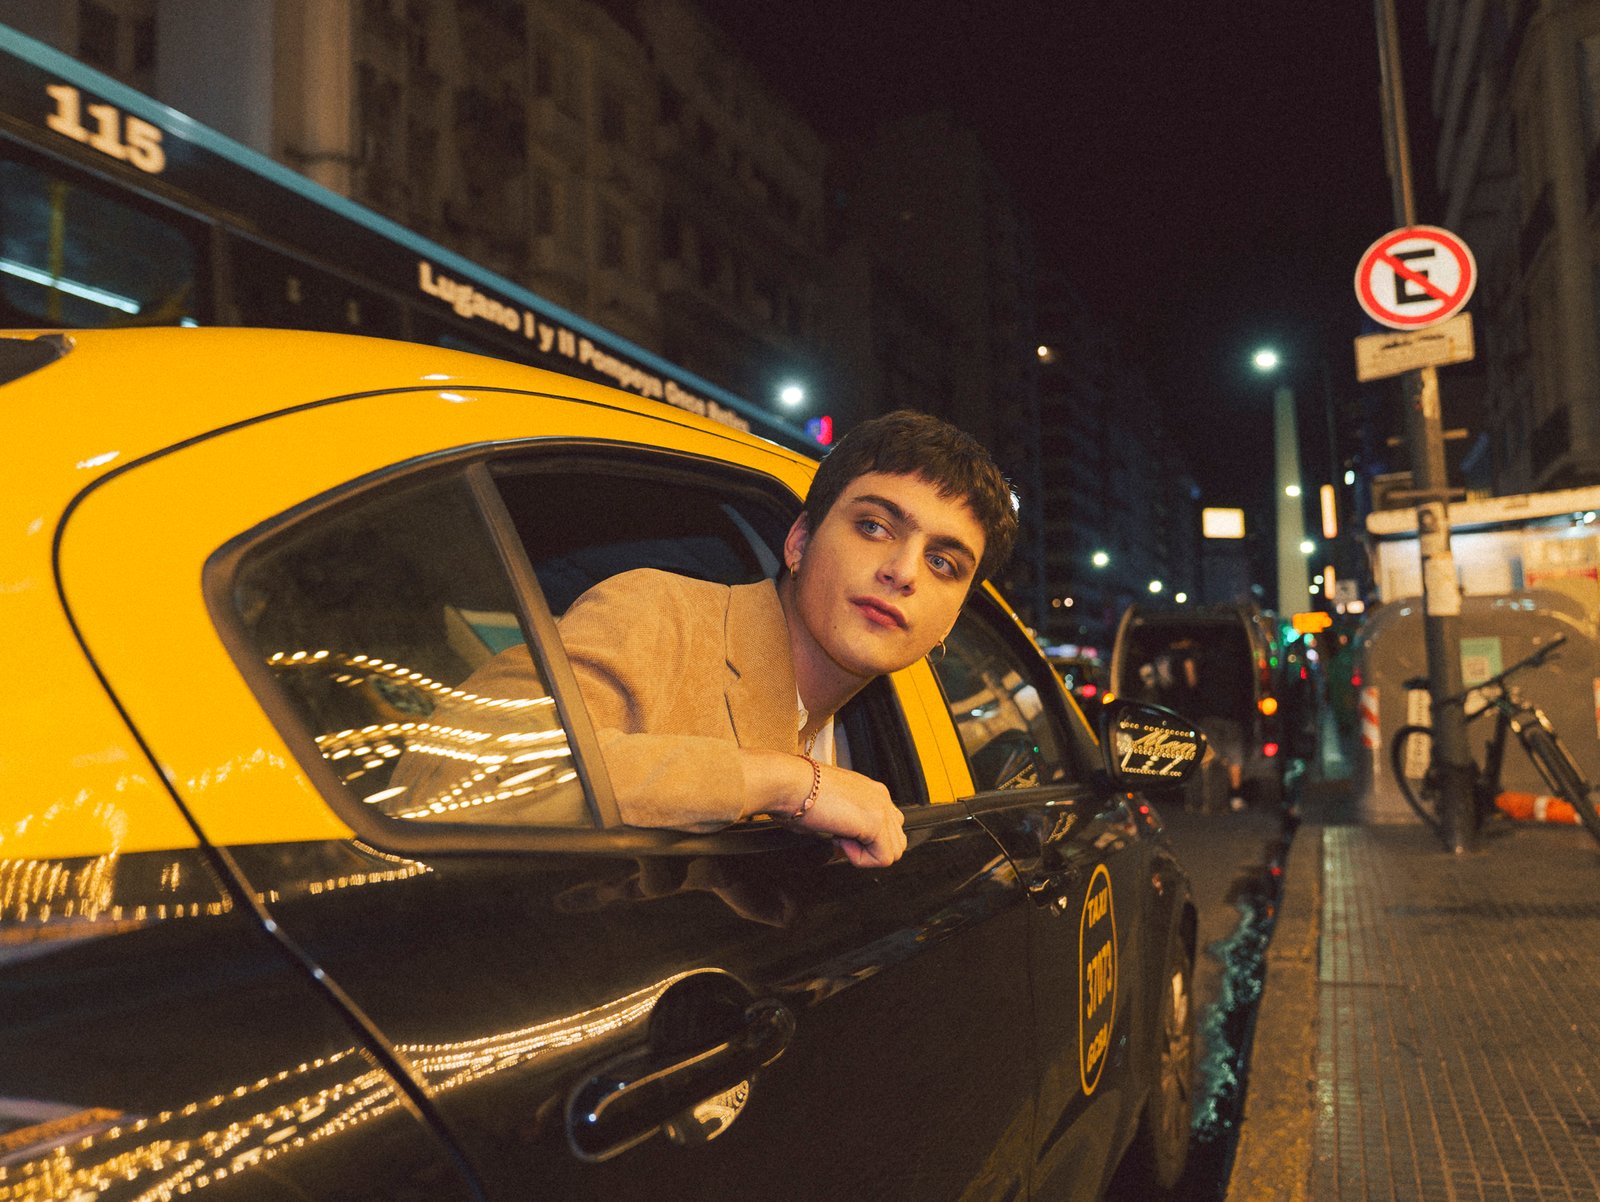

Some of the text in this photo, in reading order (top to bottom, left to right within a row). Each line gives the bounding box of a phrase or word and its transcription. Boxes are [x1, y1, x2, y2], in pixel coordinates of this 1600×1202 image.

[46, 84, 166, 174] 115
[418, 261, 521, 332] Lugano
[538, 322, 554, 353] y
[1087, 887, 1108, 929] TAXI
